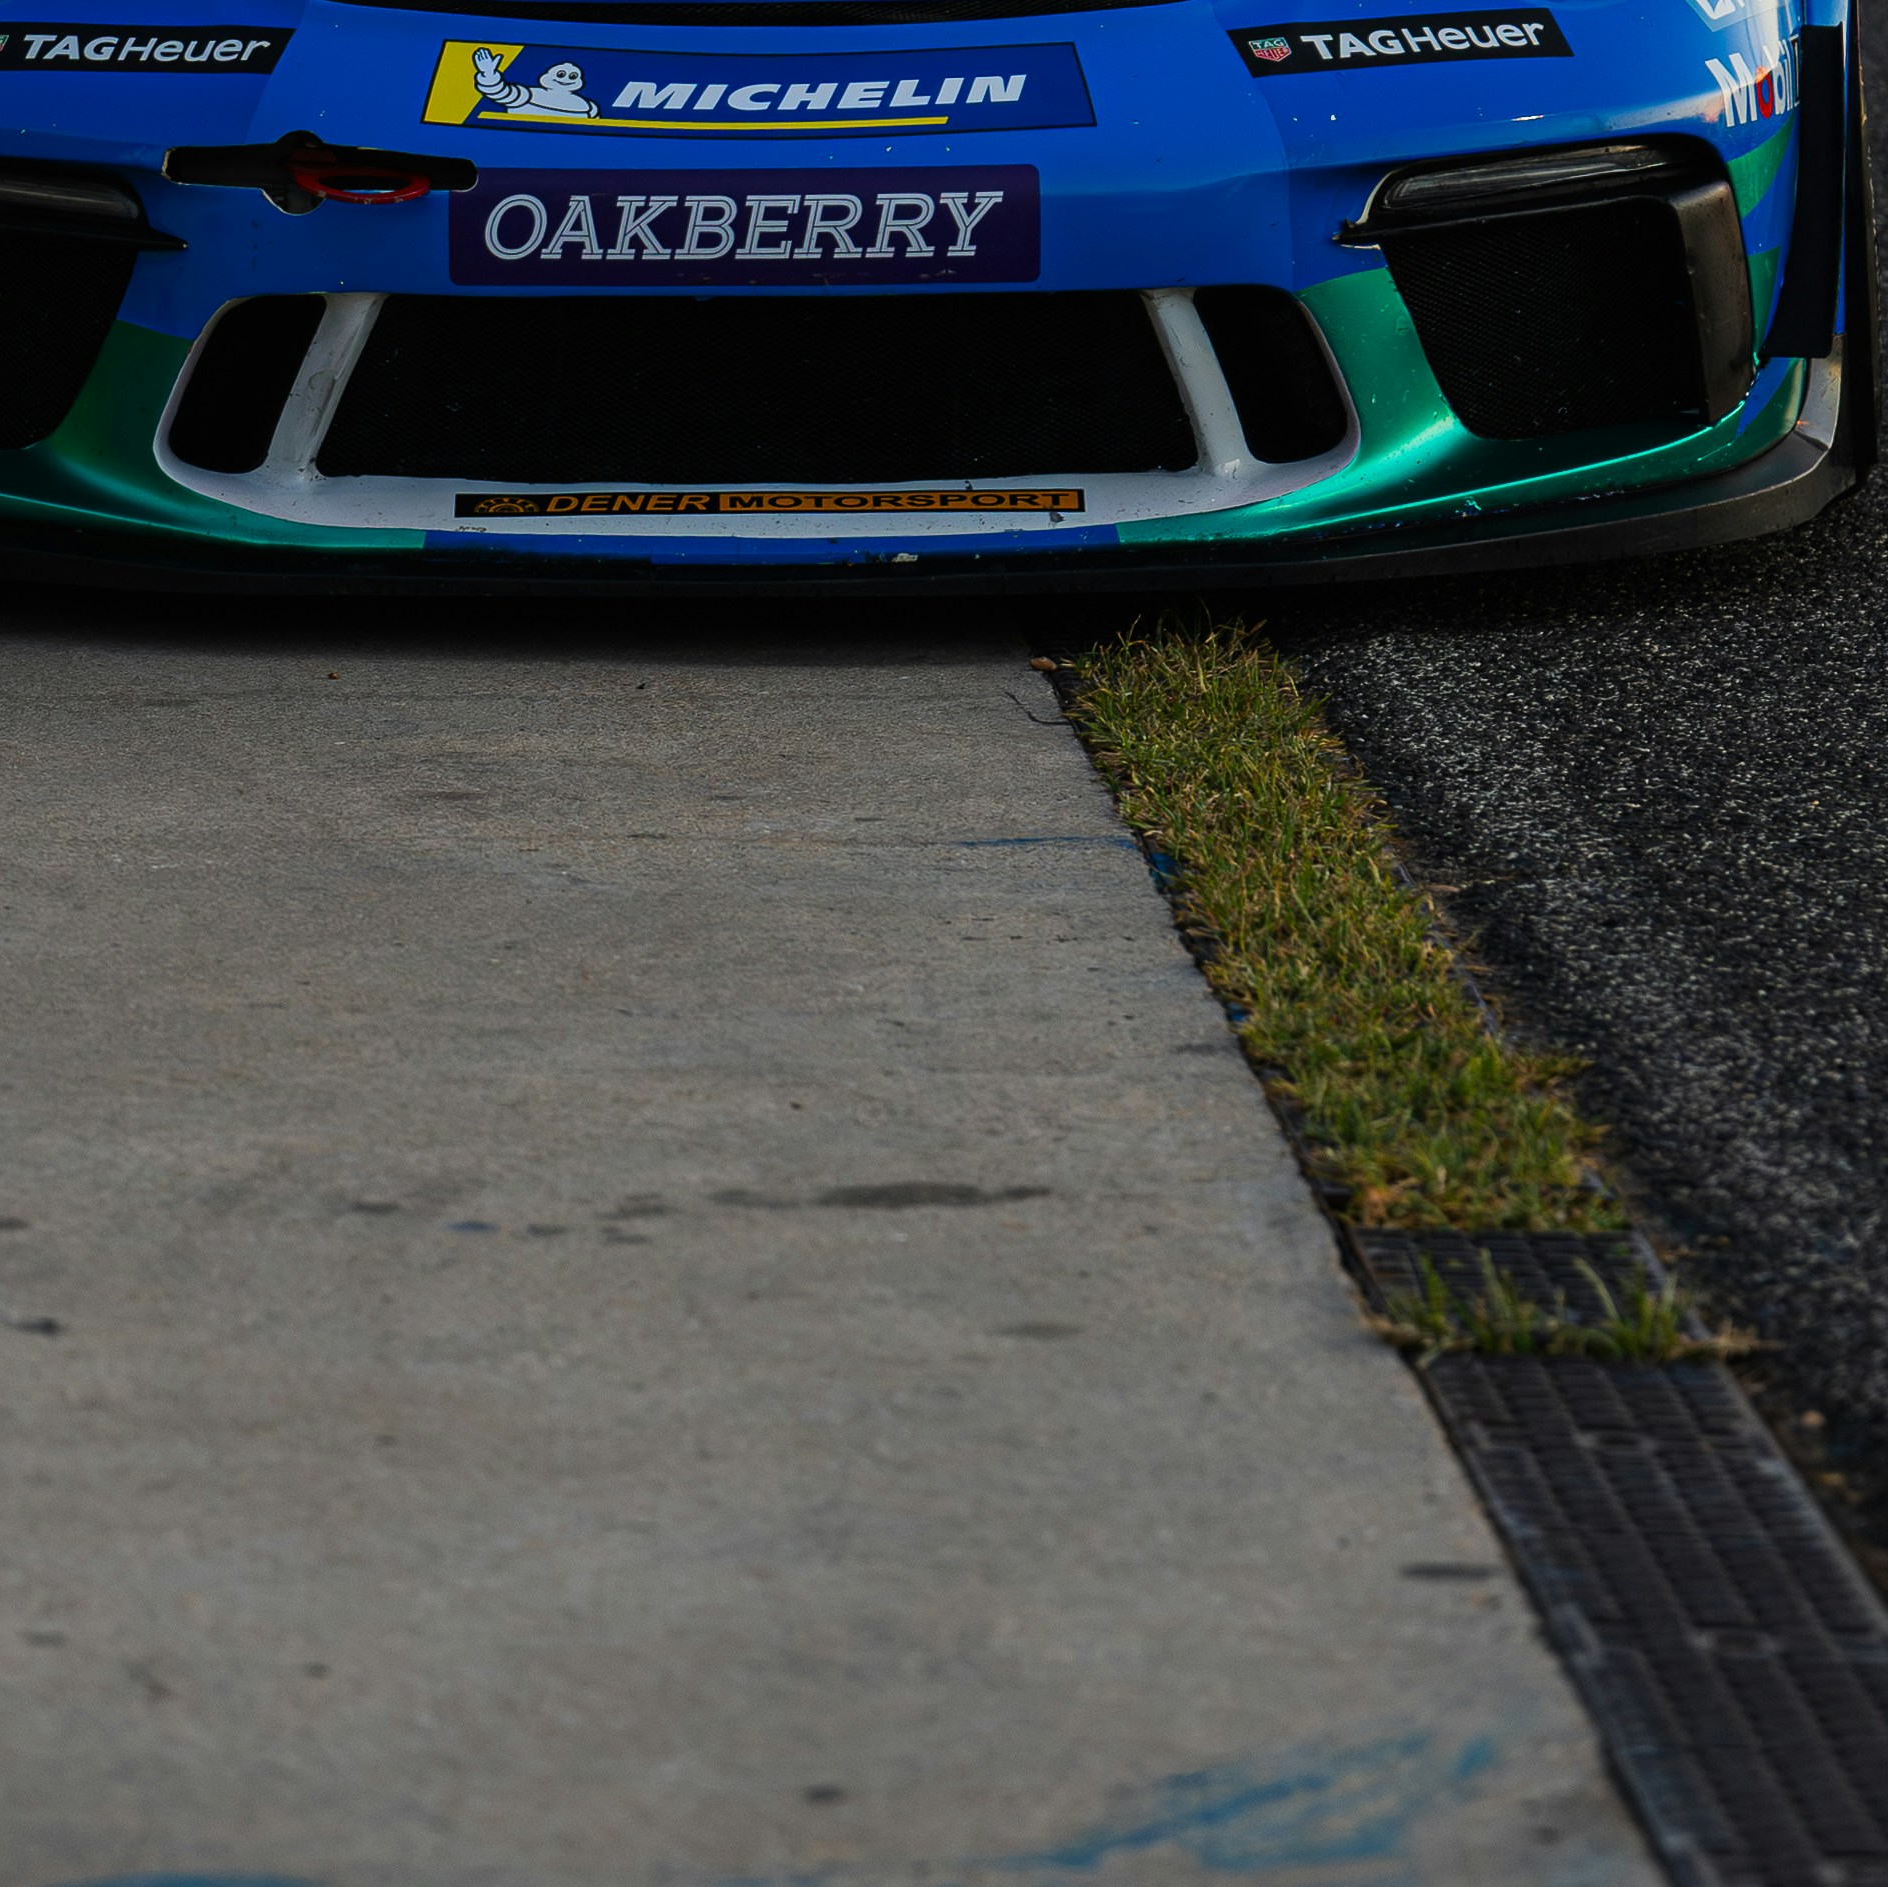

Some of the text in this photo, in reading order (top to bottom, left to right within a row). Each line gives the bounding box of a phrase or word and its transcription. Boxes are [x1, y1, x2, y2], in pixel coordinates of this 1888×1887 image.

[612, 73, 1028, 111] MICHELIN
[1704, 38, 1794, 128] Mobil
[484, 190, 1005, 261] OAKBERRY
[546, 493, 1070, 512] DENER MOTORSPORT
